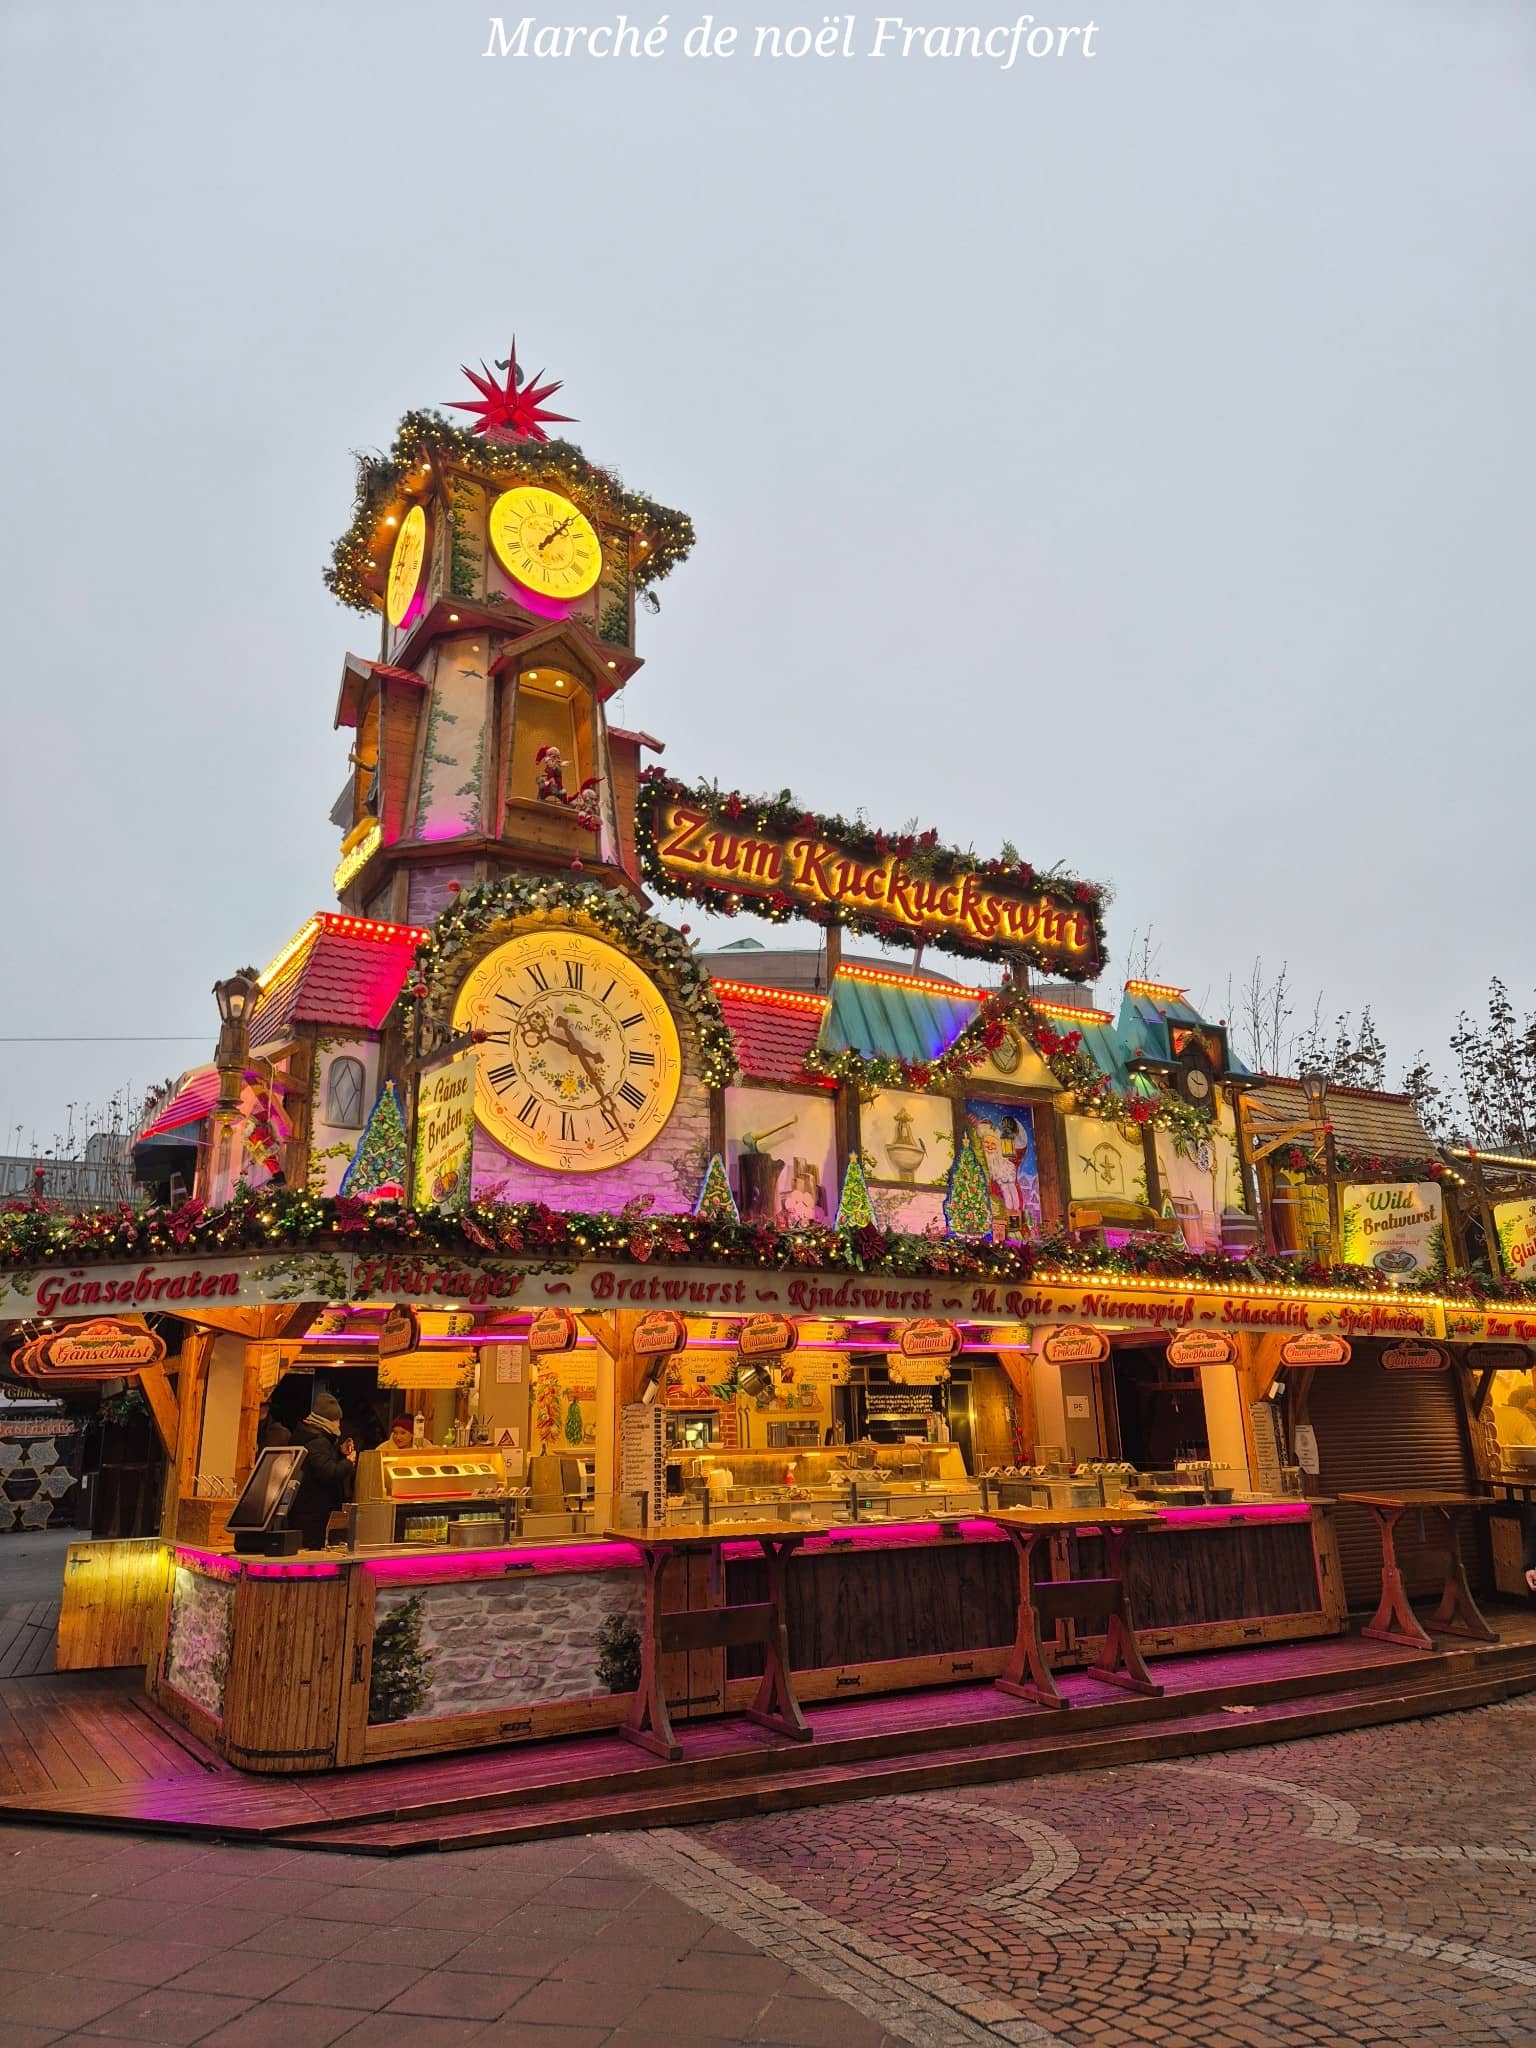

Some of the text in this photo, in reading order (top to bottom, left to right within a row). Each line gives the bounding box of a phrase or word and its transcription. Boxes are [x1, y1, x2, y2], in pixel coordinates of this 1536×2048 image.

[662, 809, 1090, 948] Zum Kuckuckswirt
[434, 1075, 469, 1118] Gänse
[428, 1107, 464, 1153] Braten
[1366, 1190, 1414, 1212] Wild
[1362, 1204, 1437, 1236] Bratwurst
[36, 1266, 240, 1317] Gänsebraten
[353, 1256, 526, 1305] Thüringer
[590, 1271, 747, 1304] Bratwurst
[787, 1277, 935, 1312] Rindswurst
[972, 1288, 1053, 1319] M. Roie
[1081, 1294, 1195, 1327] Nierenspieß
[1221, 1300, 1313, 1331] Schaschlik
[56, 1342, 151, 1364] Gänsebrust
[7, 1388, 51, 1399] Glühwe
